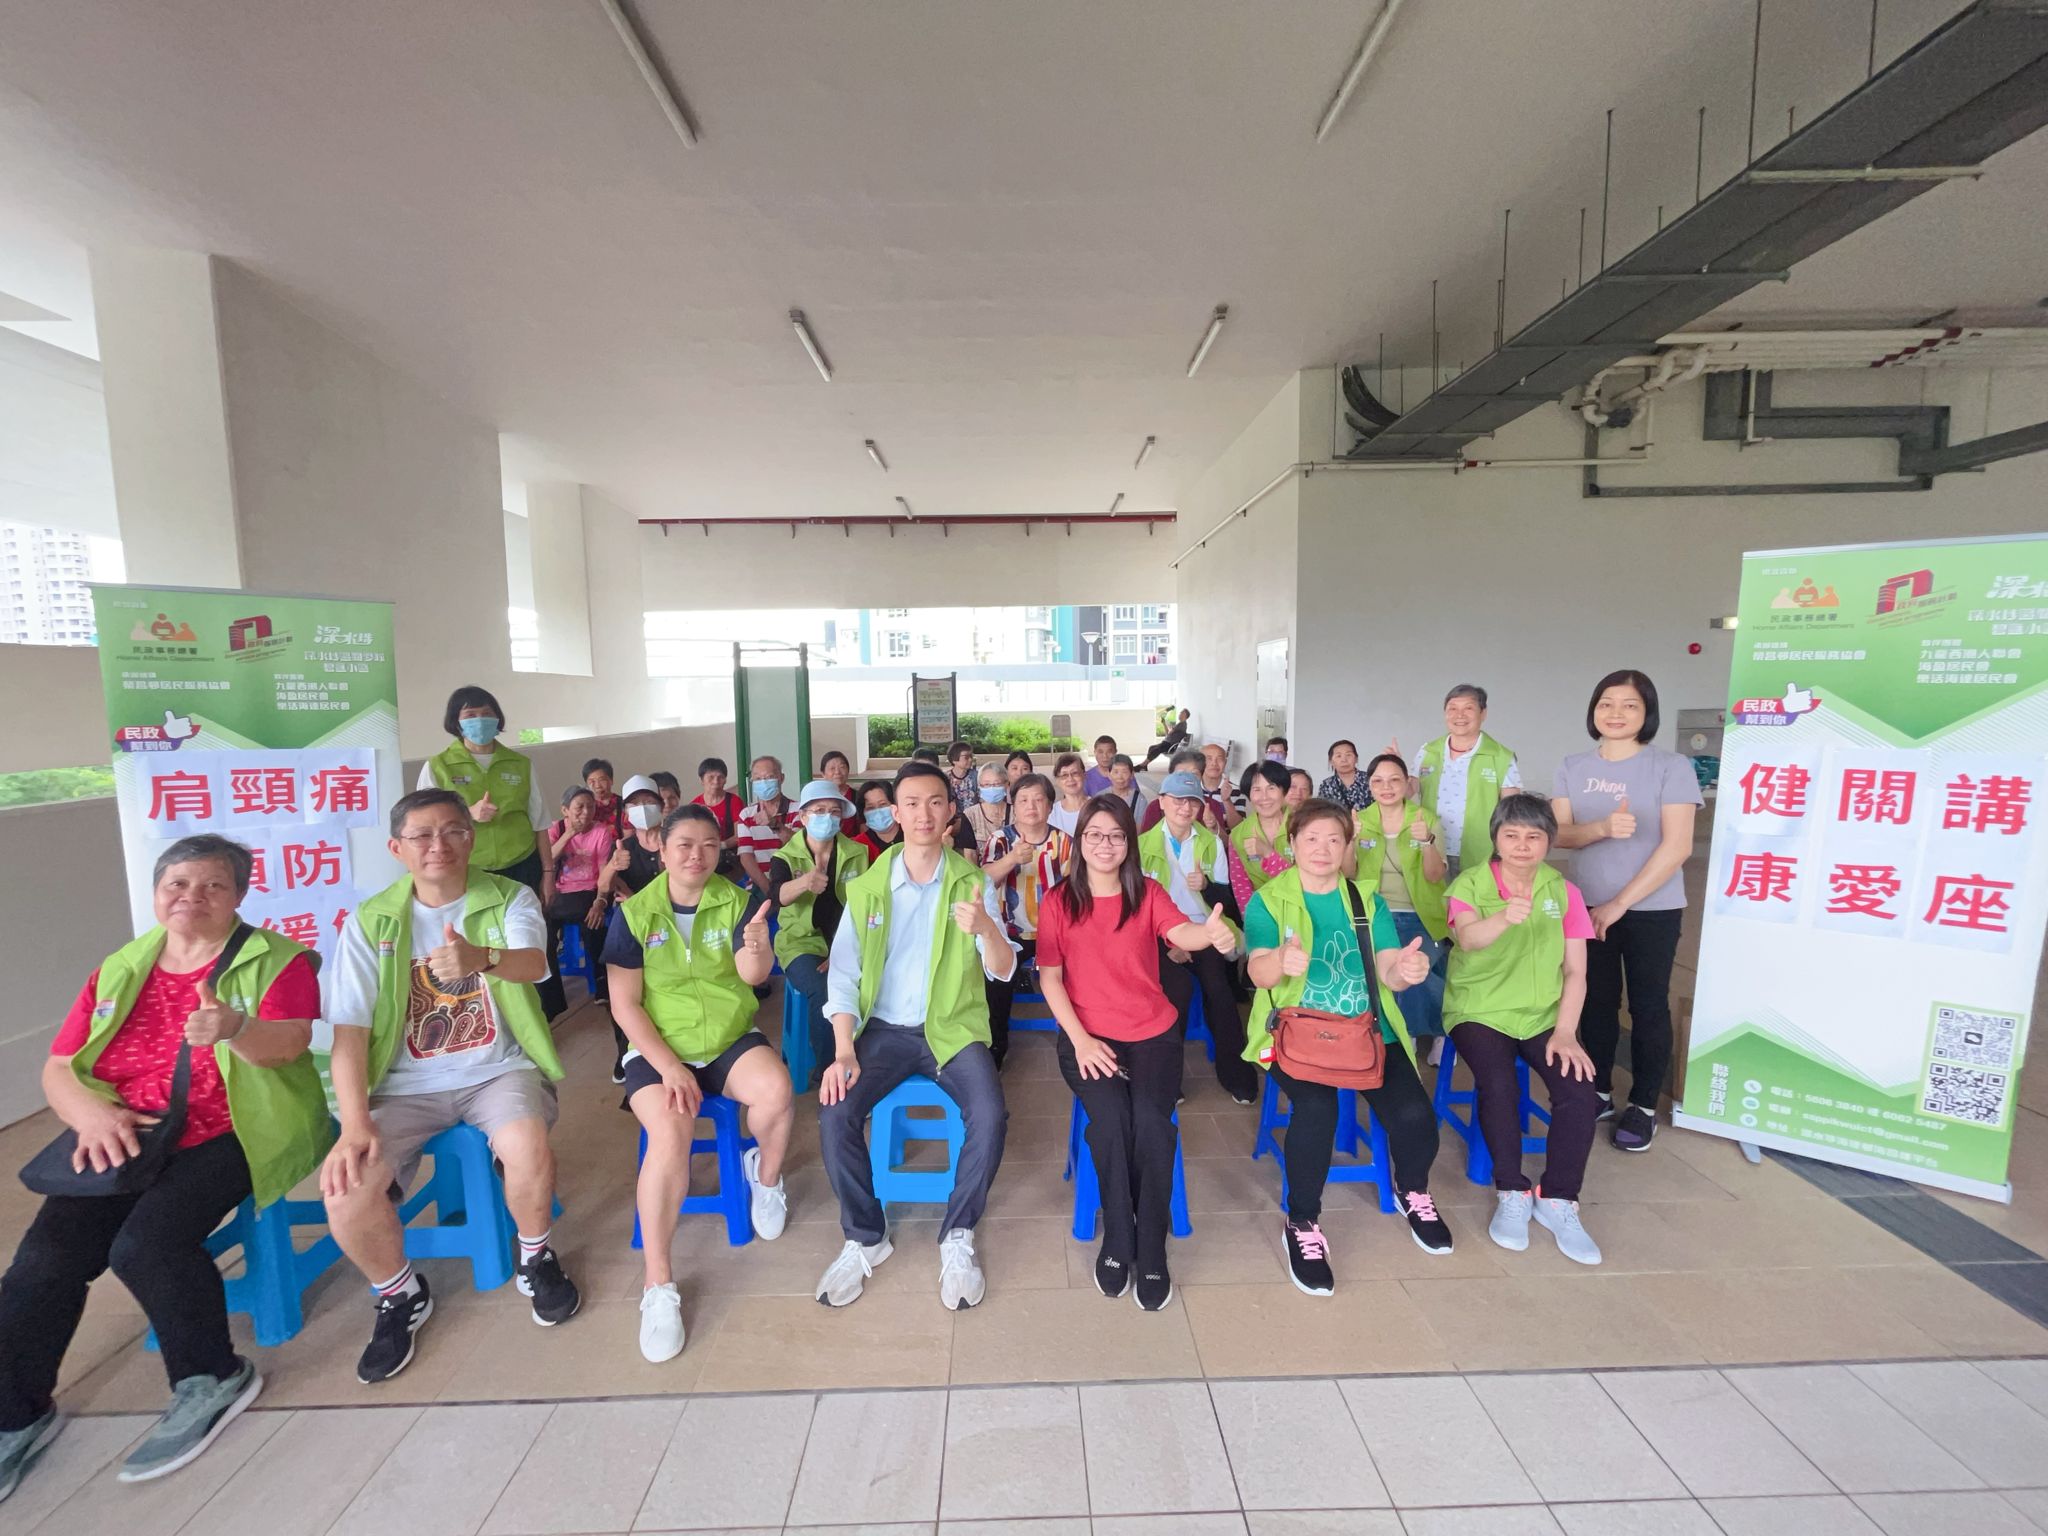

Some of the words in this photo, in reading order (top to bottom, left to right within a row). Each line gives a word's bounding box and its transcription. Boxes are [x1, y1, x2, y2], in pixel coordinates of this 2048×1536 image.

[1742, 699, 1778, 713] 民政
[124, 727, 160, 740] 民政
[148, 765, 370, 822] 肩頸痛
